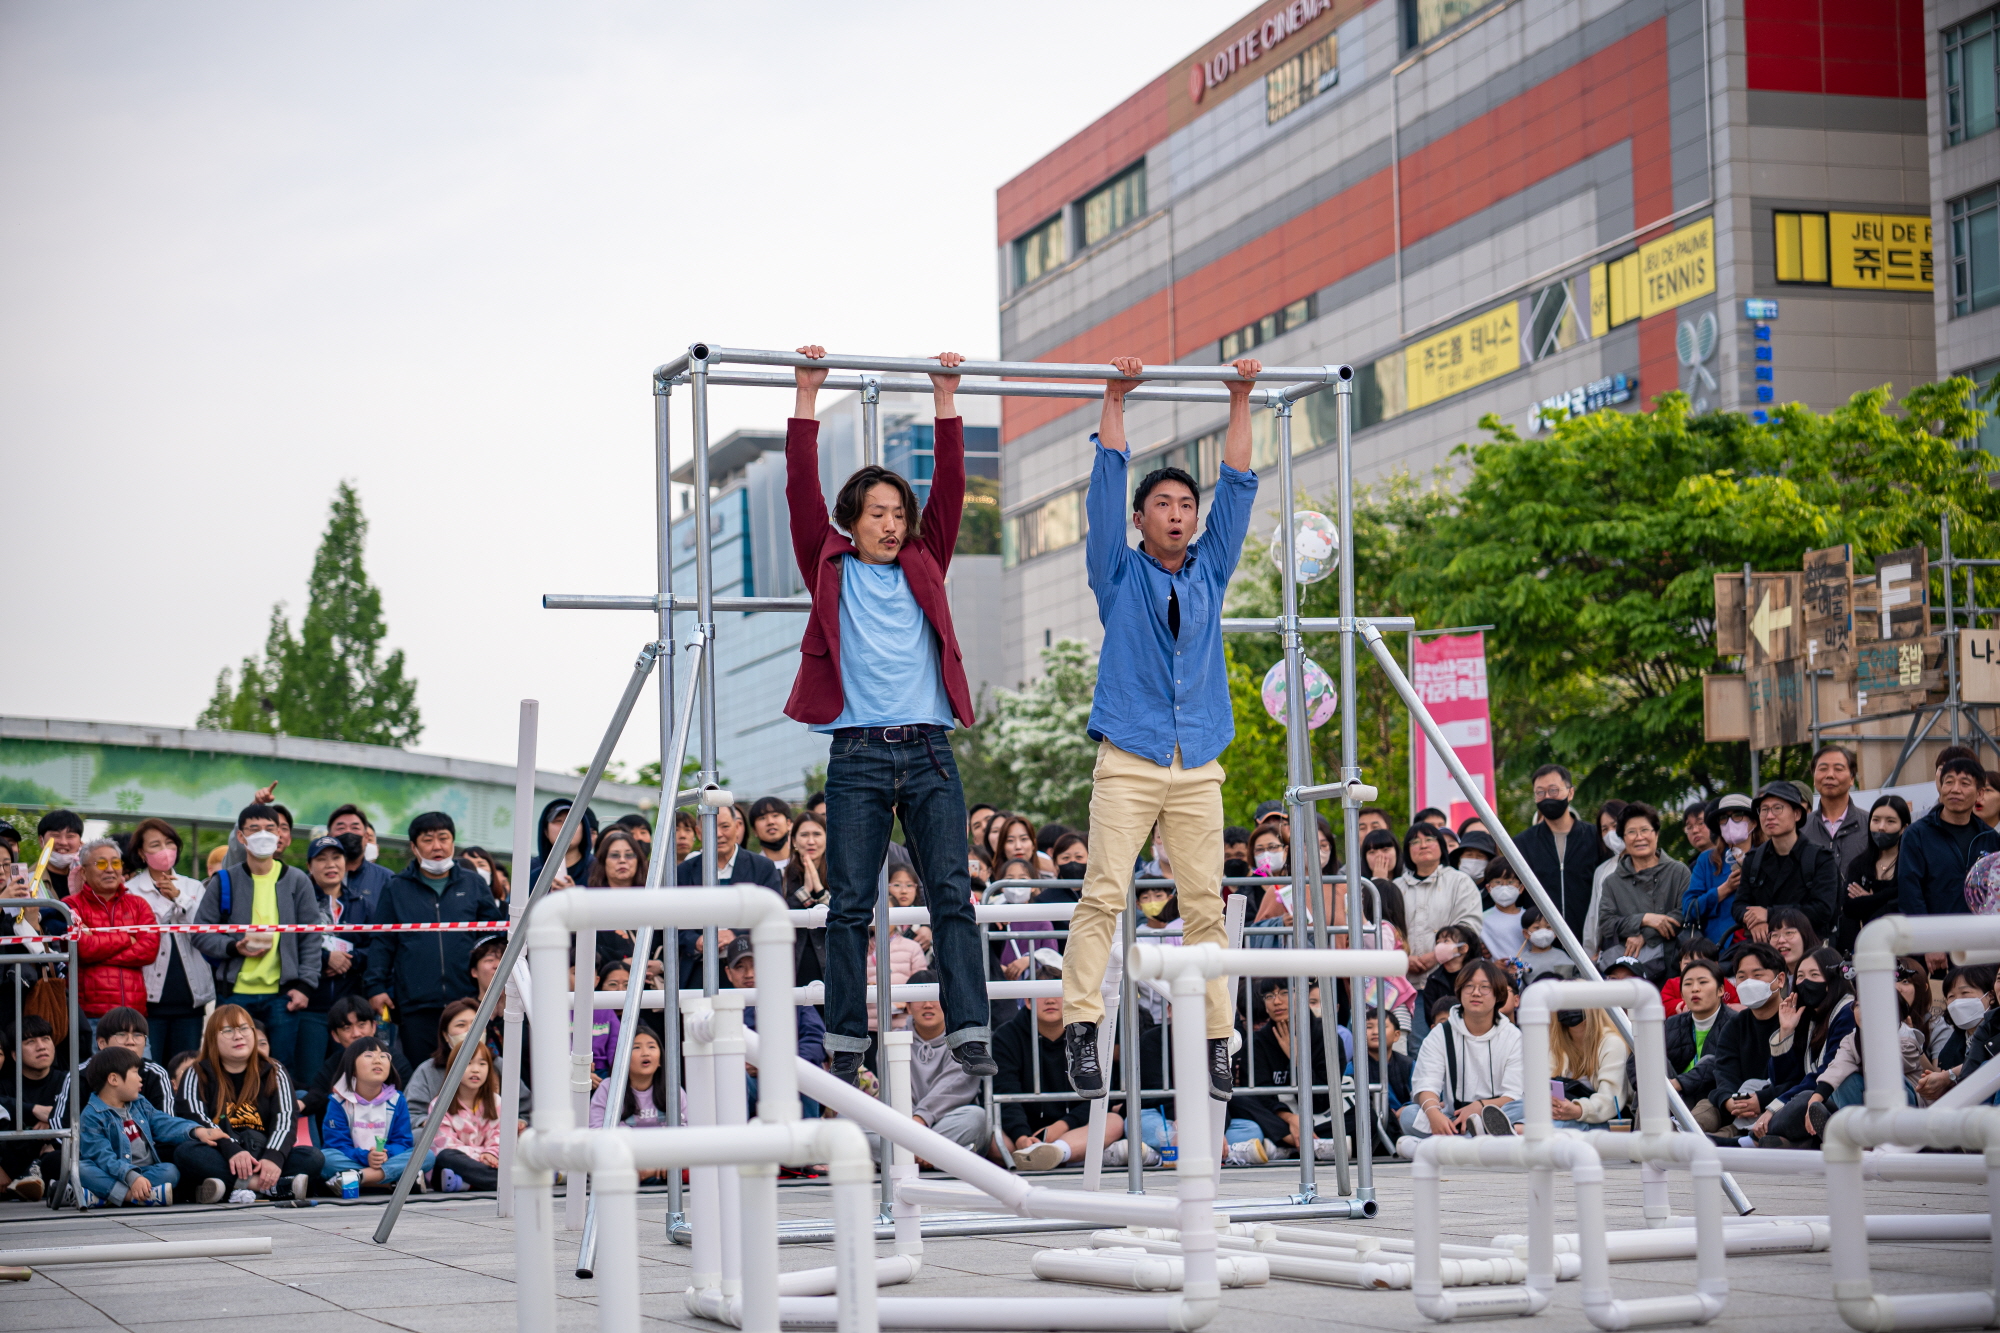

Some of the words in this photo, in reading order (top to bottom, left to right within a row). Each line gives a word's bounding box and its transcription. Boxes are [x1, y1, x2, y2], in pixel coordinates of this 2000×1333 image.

[1205, 29, 1261, 88] LOTTE
[1852, 221, 1883, 242] JEU
[1892, 223, 1916, 243] DE
[1661, 244, 1674, 265] DE
[1649, 257, 1705, 304] TENNIS
[1470, 314, 1513, 354] 테니스
[1881, 563, 1912, 639] F
[1899, 643, 1924, 686] 출발
[1971, 638, 2000, 664] 나
[1857, 690, 1867, 716] F
